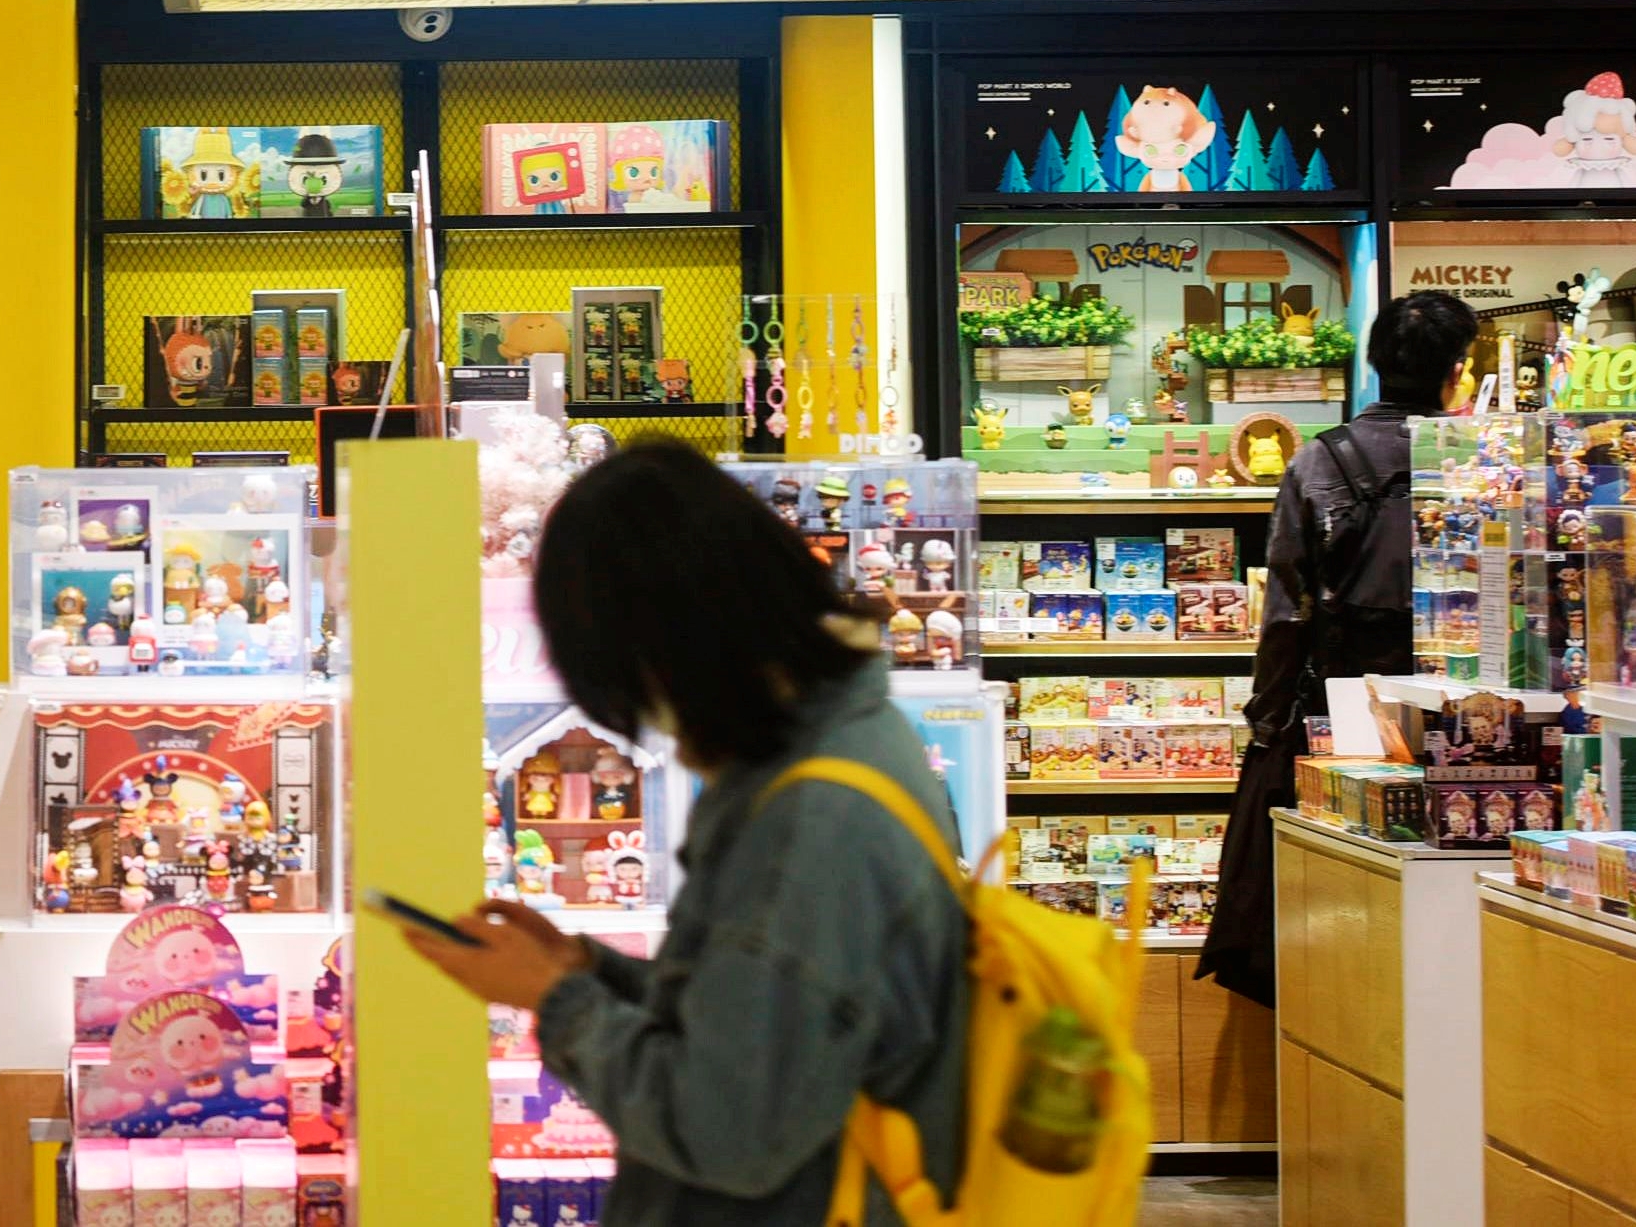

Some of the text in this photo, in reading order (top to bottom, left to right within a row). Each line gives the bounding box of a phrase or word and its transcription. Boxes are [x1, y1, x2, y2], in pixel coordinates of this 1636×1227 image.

[1409, 264, 1514, 285] MICKEY
[964, 286, 1021, 306] PARK
[1463, 288, 1515, 298] ORIGINAL
[838, 432, 925, 456] DIMOO
